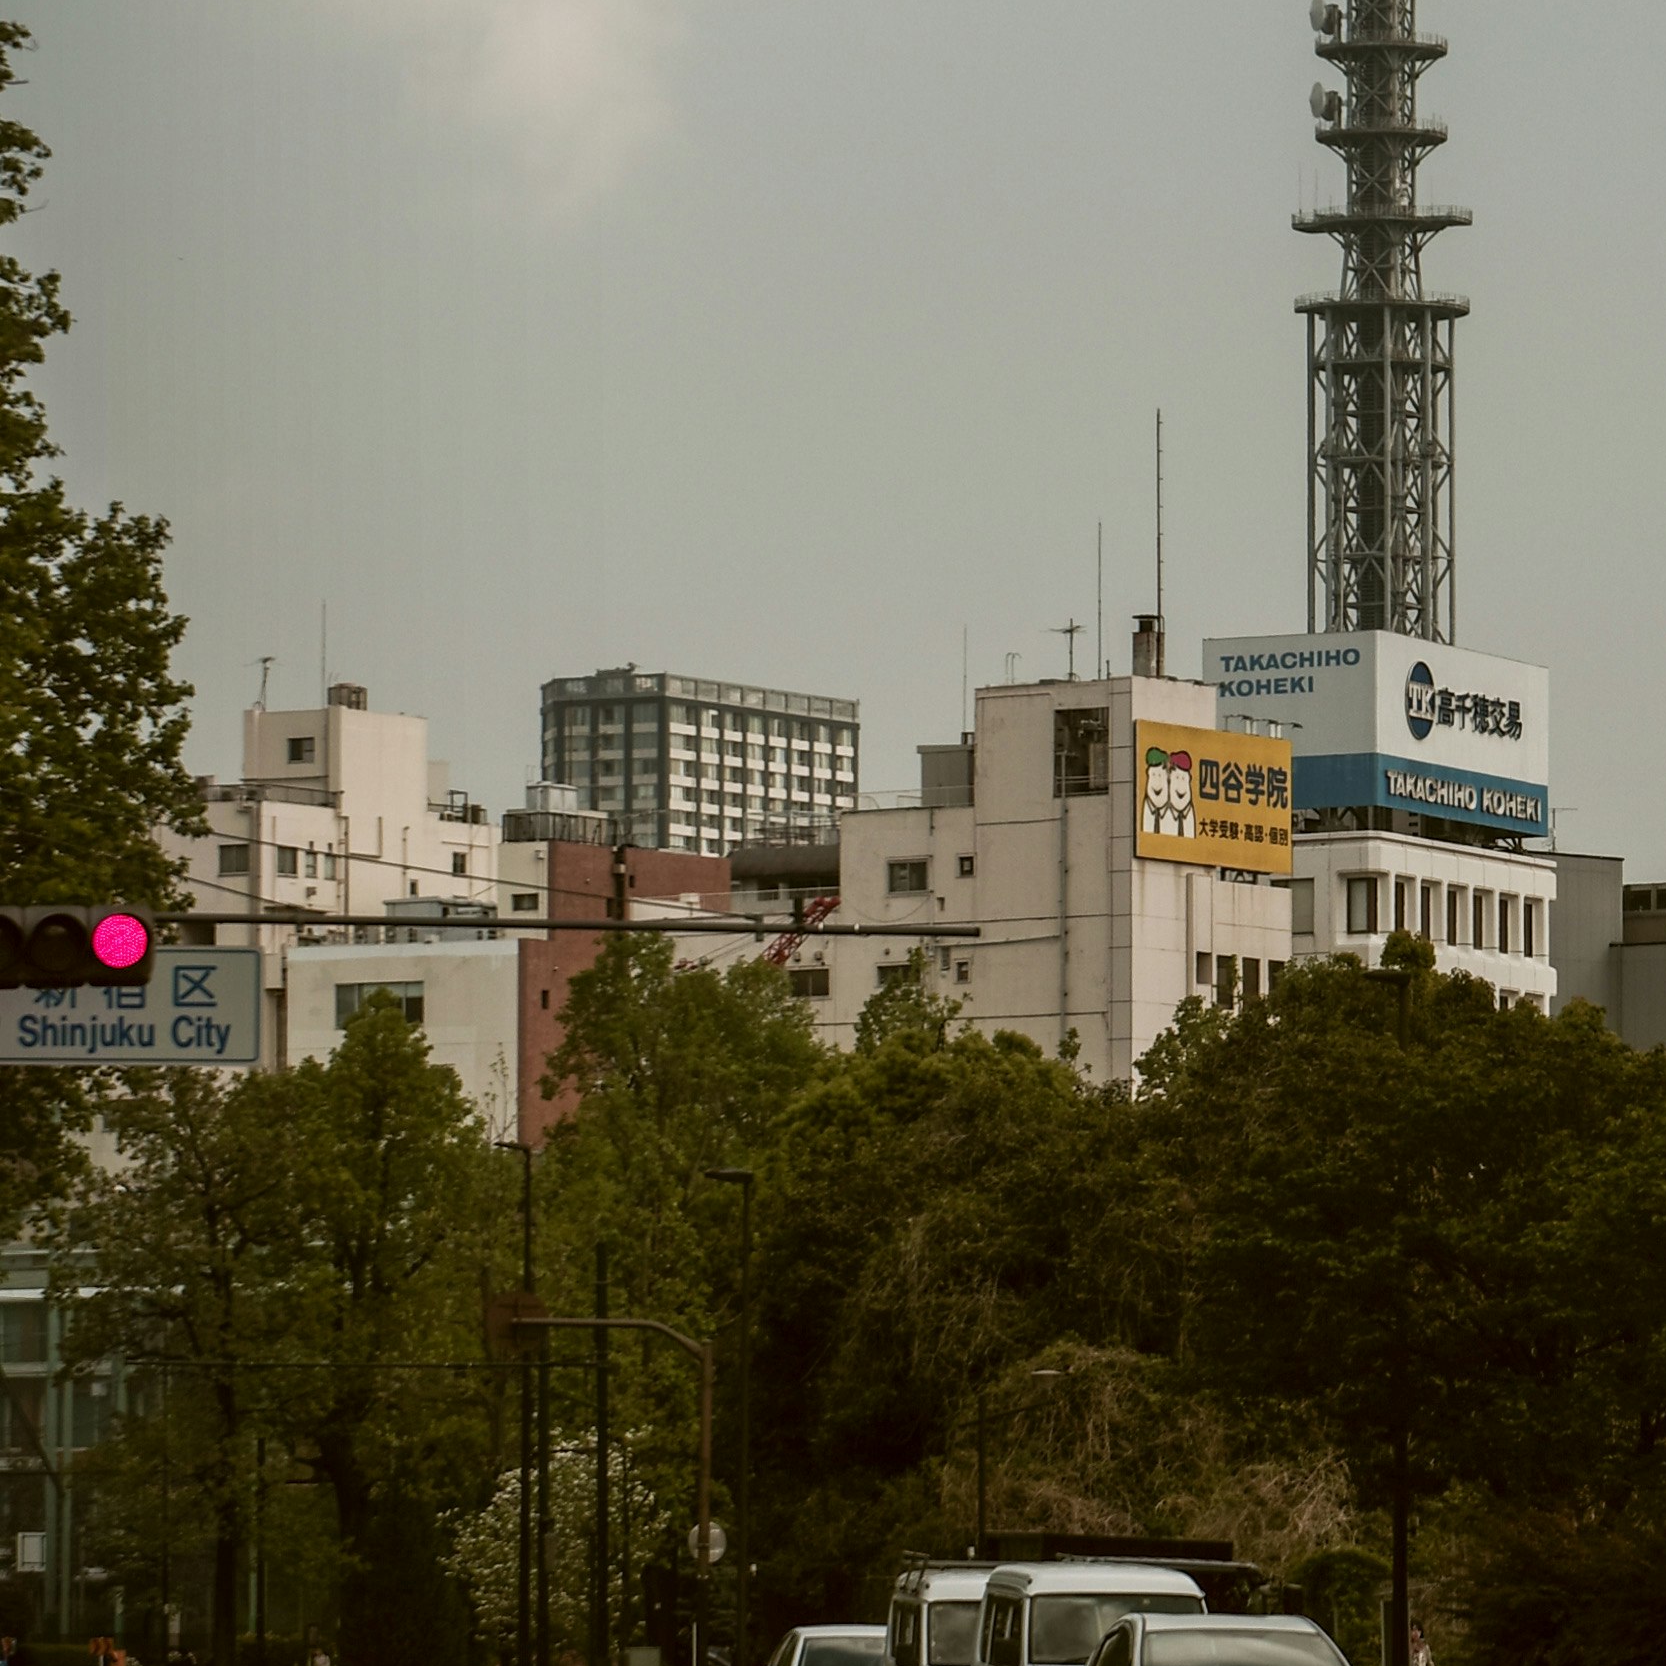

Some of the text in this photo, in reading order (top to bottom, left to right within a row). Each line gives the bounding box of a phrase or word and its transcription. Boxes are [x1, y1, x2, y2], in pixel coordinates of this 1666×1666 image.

[1219, 647, 1361, 673] TAKACHIHO
[1219, 676, 1315, 697] KOHEKI
[1436, 687, 1523, 741] 高千穂交易
[1199, 759, 1289, 810] 四谷学院
[1385, 769, 1542, 823] TAKACHIHO KOHEKI
[18, 1014, 230, 1054] Shinjuku City
